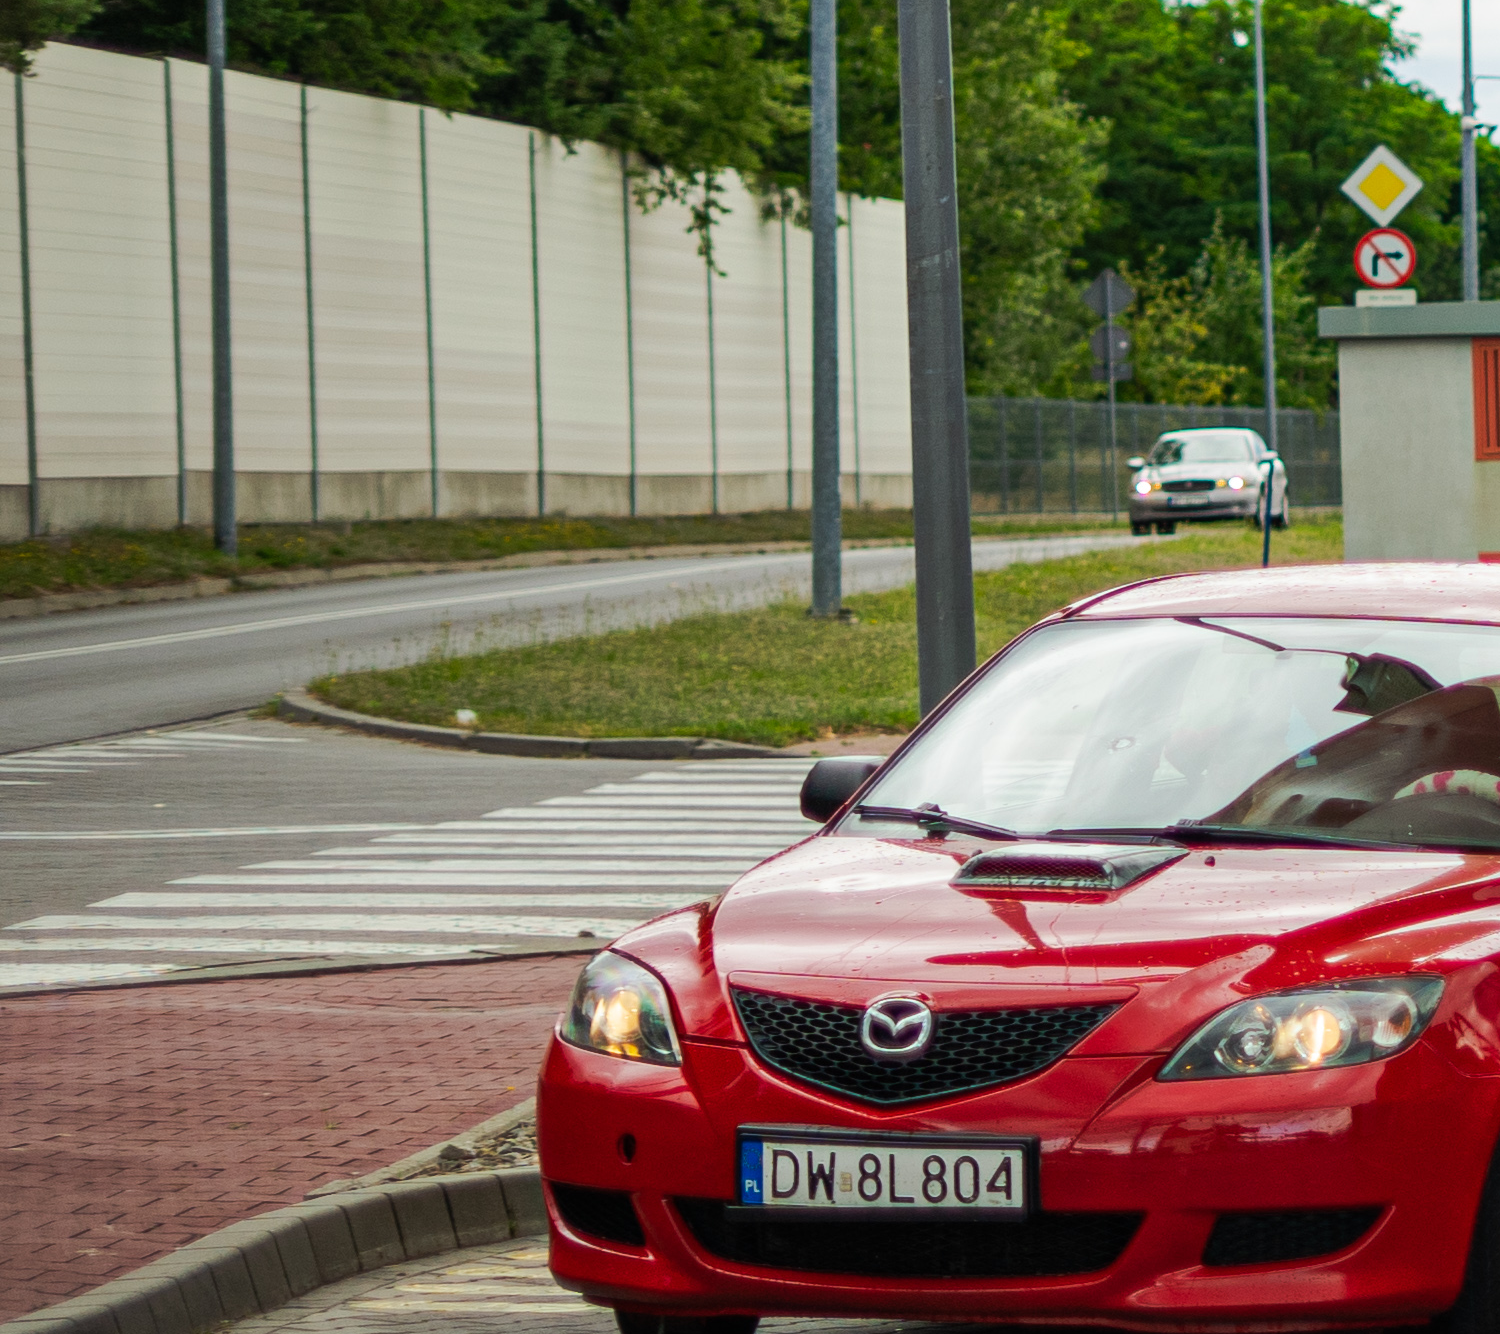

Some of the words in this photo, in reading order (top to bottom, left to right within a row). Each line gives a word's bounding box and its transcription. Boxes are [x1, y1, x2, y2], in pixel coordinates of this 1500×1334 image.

[744, 1179, 760, 1193] PL
[771, 1149, 836, 1201] DW
[858, 1153, 1013, 1204] 8L804
